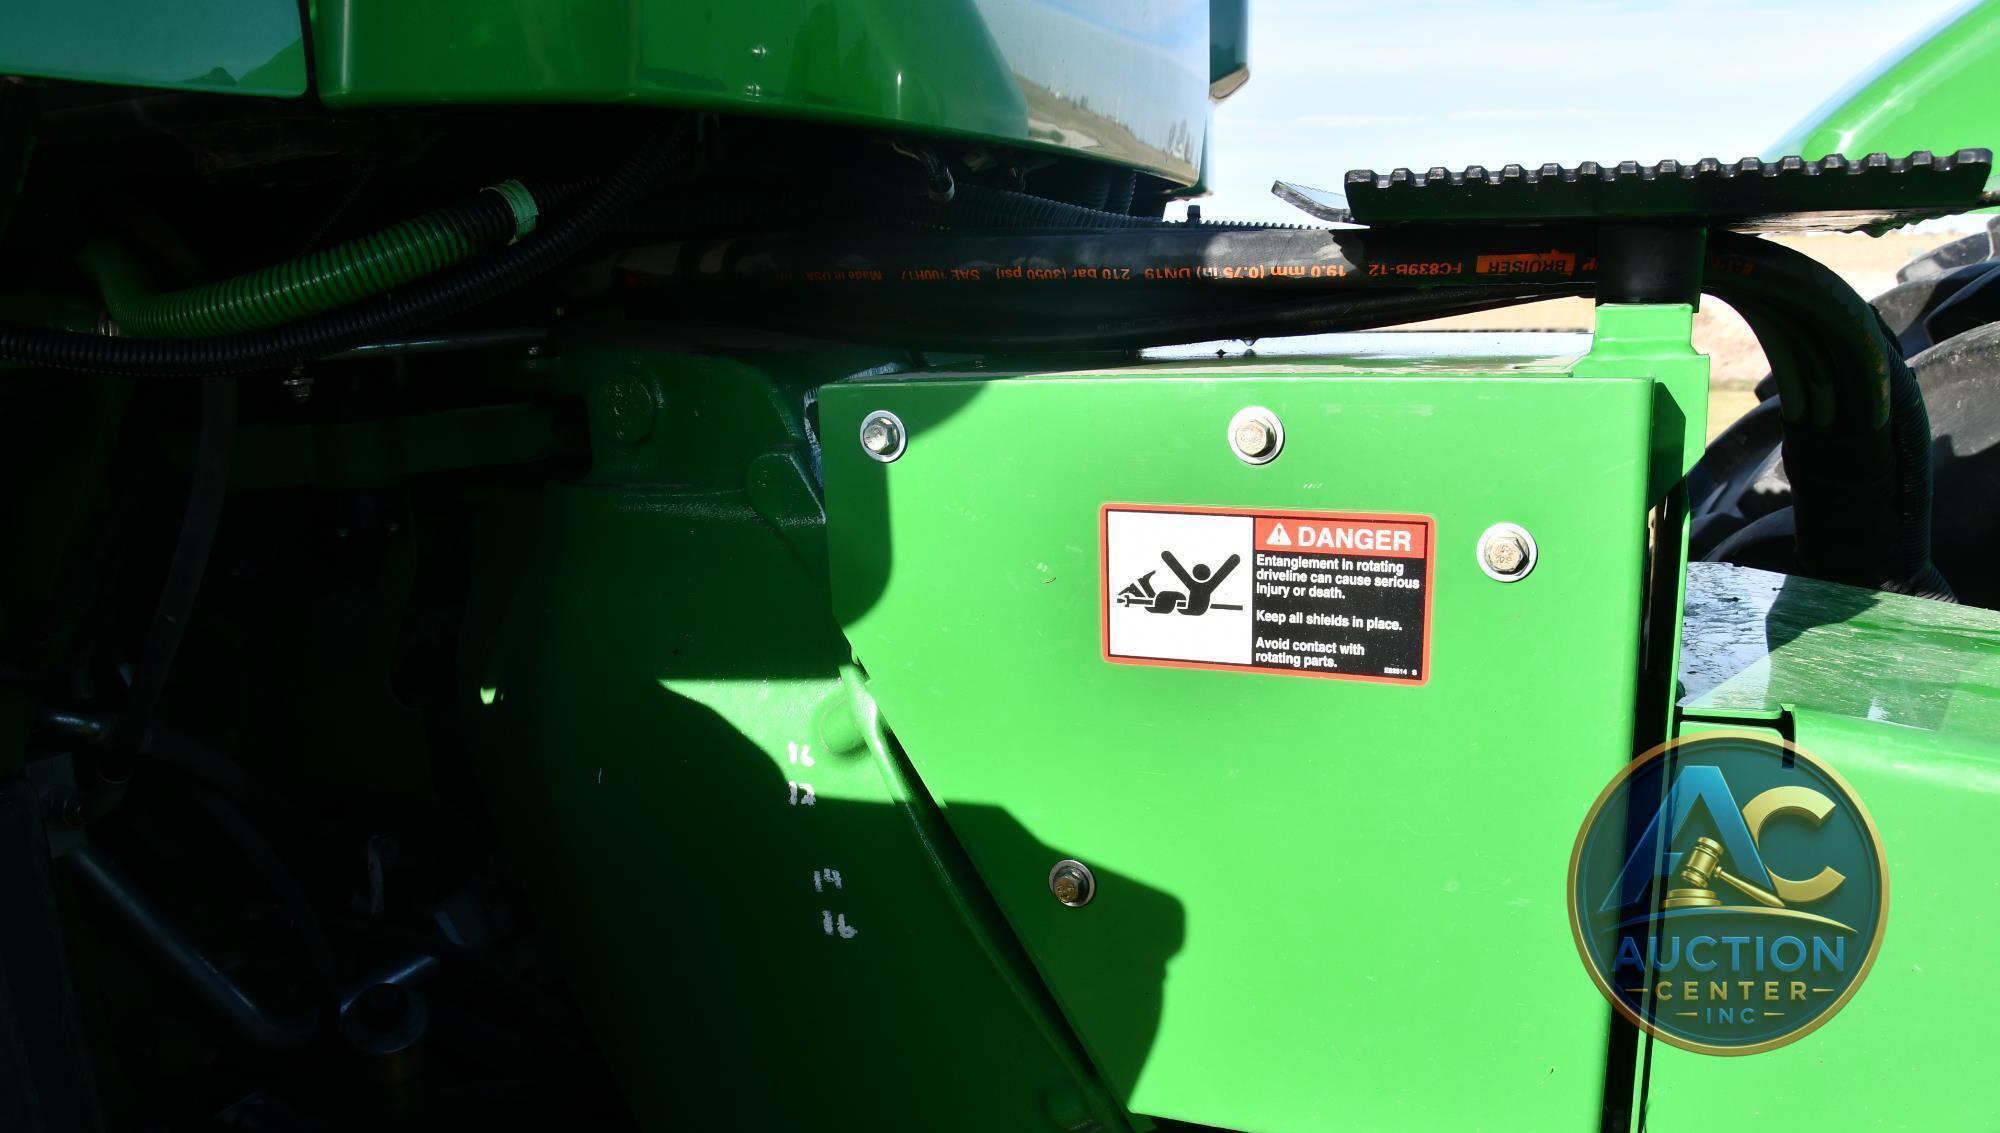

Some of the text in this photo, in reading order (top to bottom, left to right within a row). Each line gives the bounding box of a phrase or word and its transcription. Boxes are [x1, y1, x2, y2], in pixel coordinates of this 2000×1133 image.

[951, 269, 981, 280] SAE
[1072, 267, 1098, 280] bar
[1102, 268, 1130, 280] 210
[1223, 264, 1264, 280] (0.75
[1271, 266, 1306, 279] mm
[1311, 264, 1346, 278] 19.0
[1488, 259, 1566, 273] BRUISER
[1297, 526, 1412, 552] DANGER
[1256, 554, 1404, 576] Entanglement in rotating
[1256, 569, 1420, 589] driveline can cause serious
[1256, 582, 1346, 599] injury or death.
[1256, 609, 1402, 631] Keep all shields in place.
[1255, 637, 1365, 656] Avoid contact with
[1255, 651, 1338, 668] rotating parts.
[787, 741, 815, 767] 16
[813, 868, 842, 892] 14
[822, 910, 858, 939] 16
